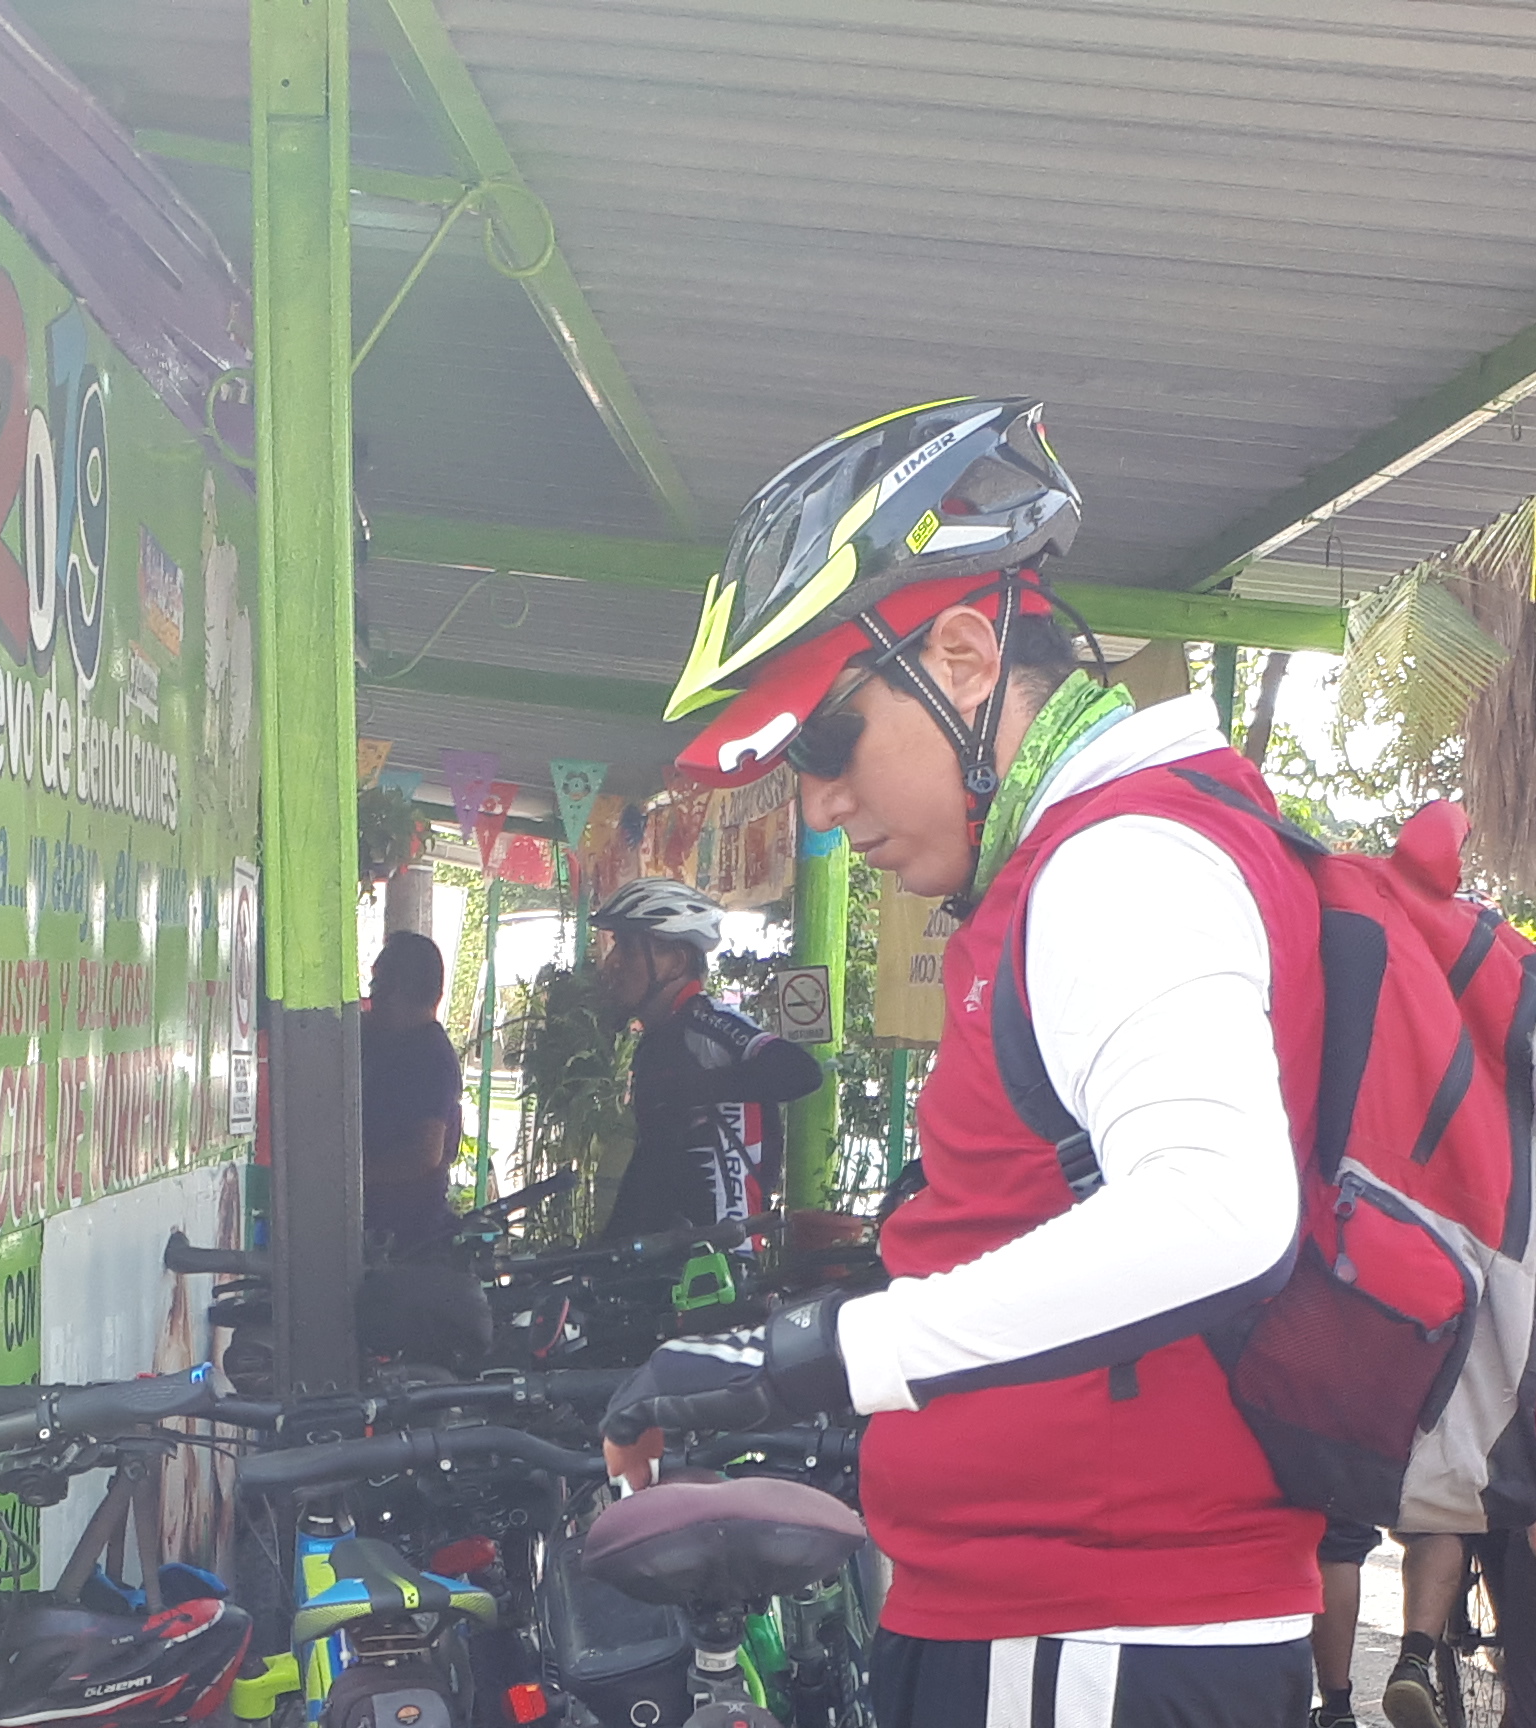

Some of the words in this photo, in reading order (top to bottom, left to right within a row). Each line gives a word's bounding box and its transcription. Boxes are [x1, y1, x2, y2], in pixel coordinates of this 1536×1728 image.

[894, 432, 957, 485] LIMAR
[40, 688, 72, 796] de
[60, 961, 71, 1031] Y
[77, 957, 152, 1032] DELICIOSA
[55, 1056, 89, 1209] DE
